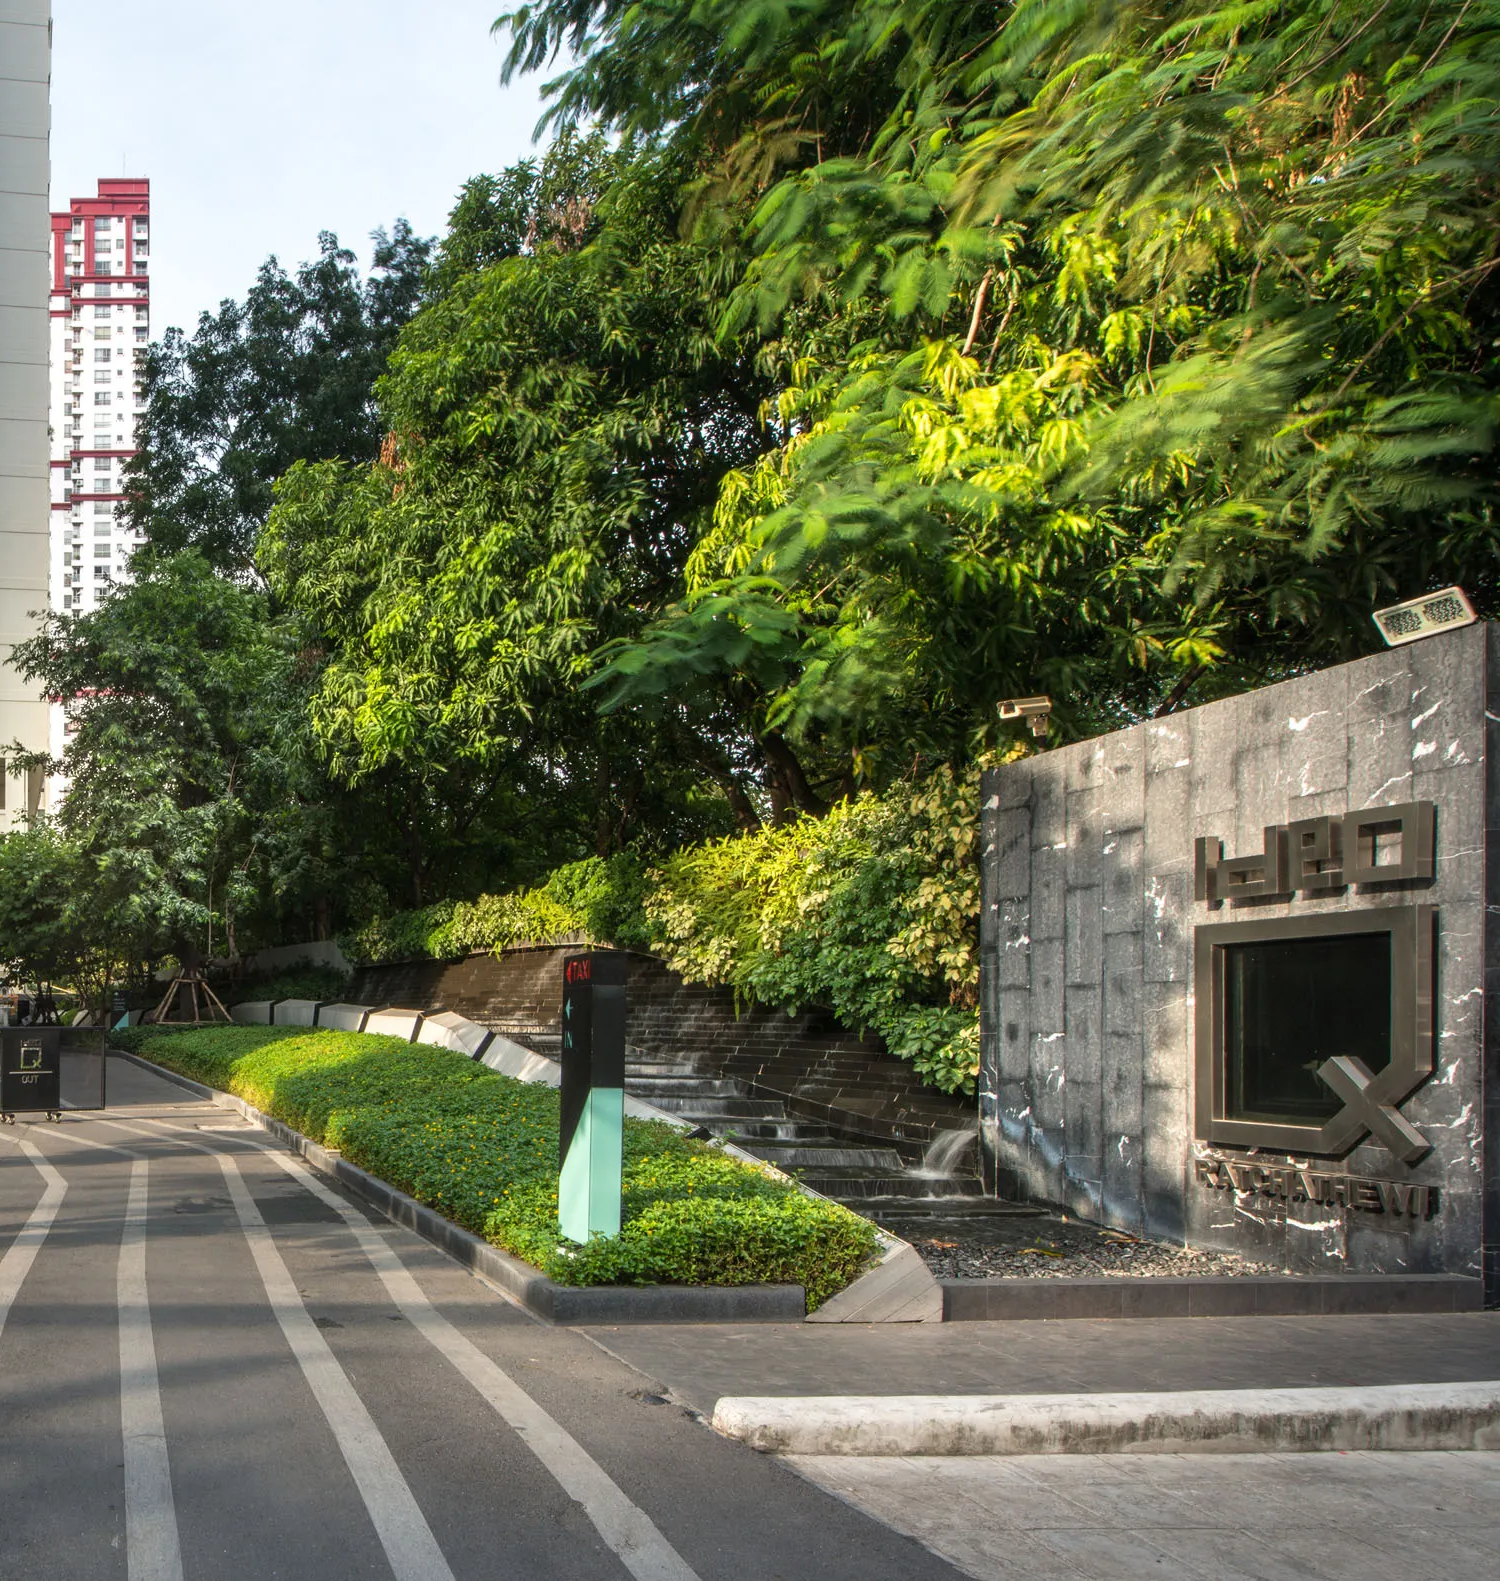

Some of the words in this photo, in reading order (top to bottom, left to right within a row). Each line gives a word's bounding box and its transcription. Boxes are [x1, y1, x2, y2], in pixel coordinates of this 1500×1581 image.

[572, 959, 591, 981] TAXI
[564, 1030, 573, 1049] IN
[21, 1075, 40, 1084] OUT
[1194, 1158, 1434, 1217] RATCHATHEWI
